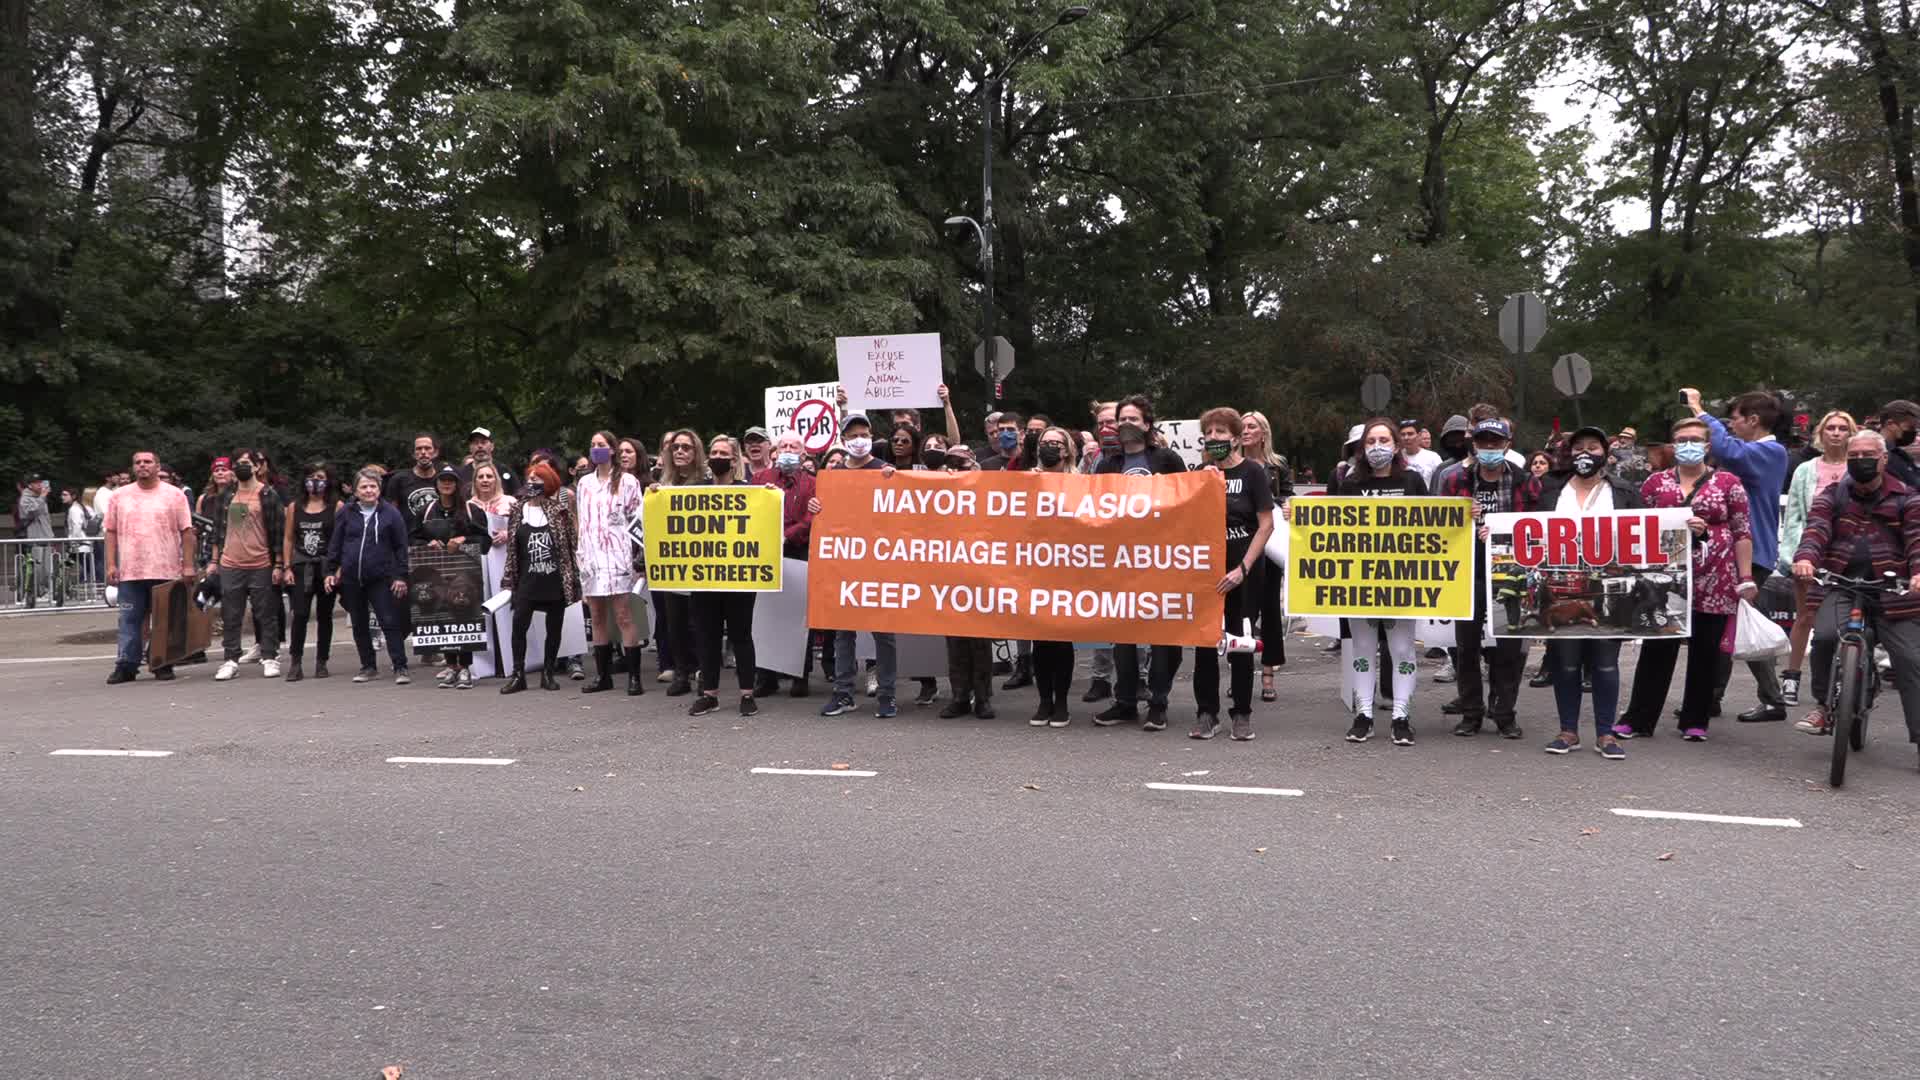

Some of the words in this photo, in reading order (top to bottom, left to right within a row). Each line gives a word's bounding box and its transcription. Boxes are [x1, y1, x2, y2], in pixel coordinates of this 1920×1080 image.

[873, 338, 889, 349] NO
[867, 351, 905, 361] EXCUSE
[875, 361, 896, 372] FOR
[867, 374, 912, 386] ANIMAL
[777, 388, 813, 402] JOIN
[865, 386, 905, 398] ABUSE
[797, 415, 831, 437] FUR
[670, 494, 747, 511] HORSES
[873, 489, 977, 515] MAYOR
[986, 491, 1028, 516] DE
[1036, 491, 1161, 519] BLASIO:
[667, 515, 751, 535] DON'T
[1295, 505, 1370, 526] HORSE
[1376, 506, 1464, 527] DRAWN
[659, 541, 728, 558] BELONG
[732, 541, 759, 558] ON
[1310, 532, 1448, 555] CARRIAGES:
[1513, 515, 1668, 567] CRUEL
[819, 536, 867, 560] END
[873, 538, 1008, 565] CARRIAGE
[1015, 542, 1106, 567] HORSE
[1113, 544, 1211, 570] ABUSE
[650, 564, 688, 581] CITY
[692, 564, 774, 582] STREETS
[1299, 559, 1354, 580] NOT
[1361, 559, 1460, 581] FAMILY
[839, 580, 921, 609] KEEP
[930, 584, 1019, 614] YOUR
[1029, 588, 1194, 620] PROMISE!
[1315, 585, 1442, 608] FRIENDLY
[416, 625, 440, 635] FUR
[444, 623, 482, 633] TRADE
[417, 636, 449, 645] DEATH
[453, 634, 482, 643] TRADE
